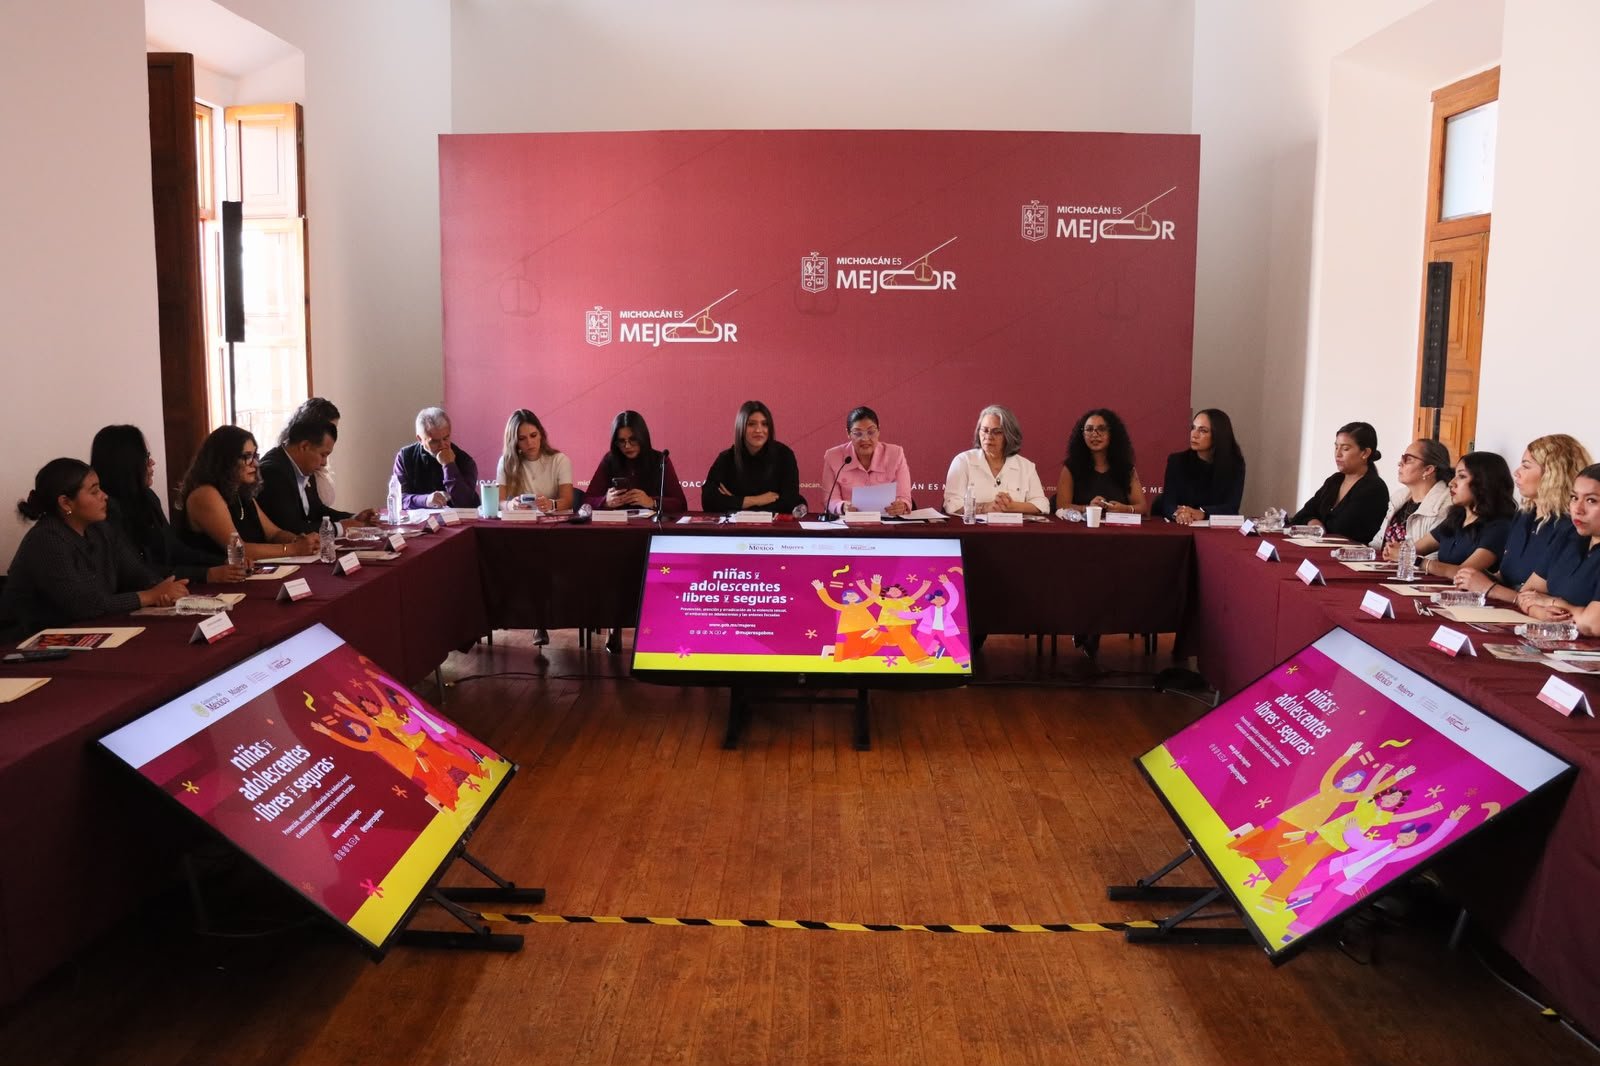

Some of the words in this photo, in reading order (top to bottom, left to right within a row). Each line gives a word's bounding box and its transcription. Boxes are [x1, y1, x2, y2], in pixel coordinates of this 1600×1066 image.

[1057, 205, 1111, 214] MICHOACÁN
[836, 256, 890, 265] MICHOACÁN
[620, 309, 672, 318] MICHOACÁN
[712, 568, 752, 580] niñas
[690, 580, 780, 592] adolescentes
[682, 592, 720, 602] libres
[733, 594, 787, 605] seguras
[1304, 688, 1336, 712] niñas
[1274, 694, 1332, 738] adolescentes
[1254, 701, 1280, 724] libres
[1277, 725, 1314, 755] seguras
[230, 742, 270, 771] niñas
[239, 745, 311, 801] adolescentes
[253, 792, 294, 822] libres
[293, 758, 335, 792] seguras
